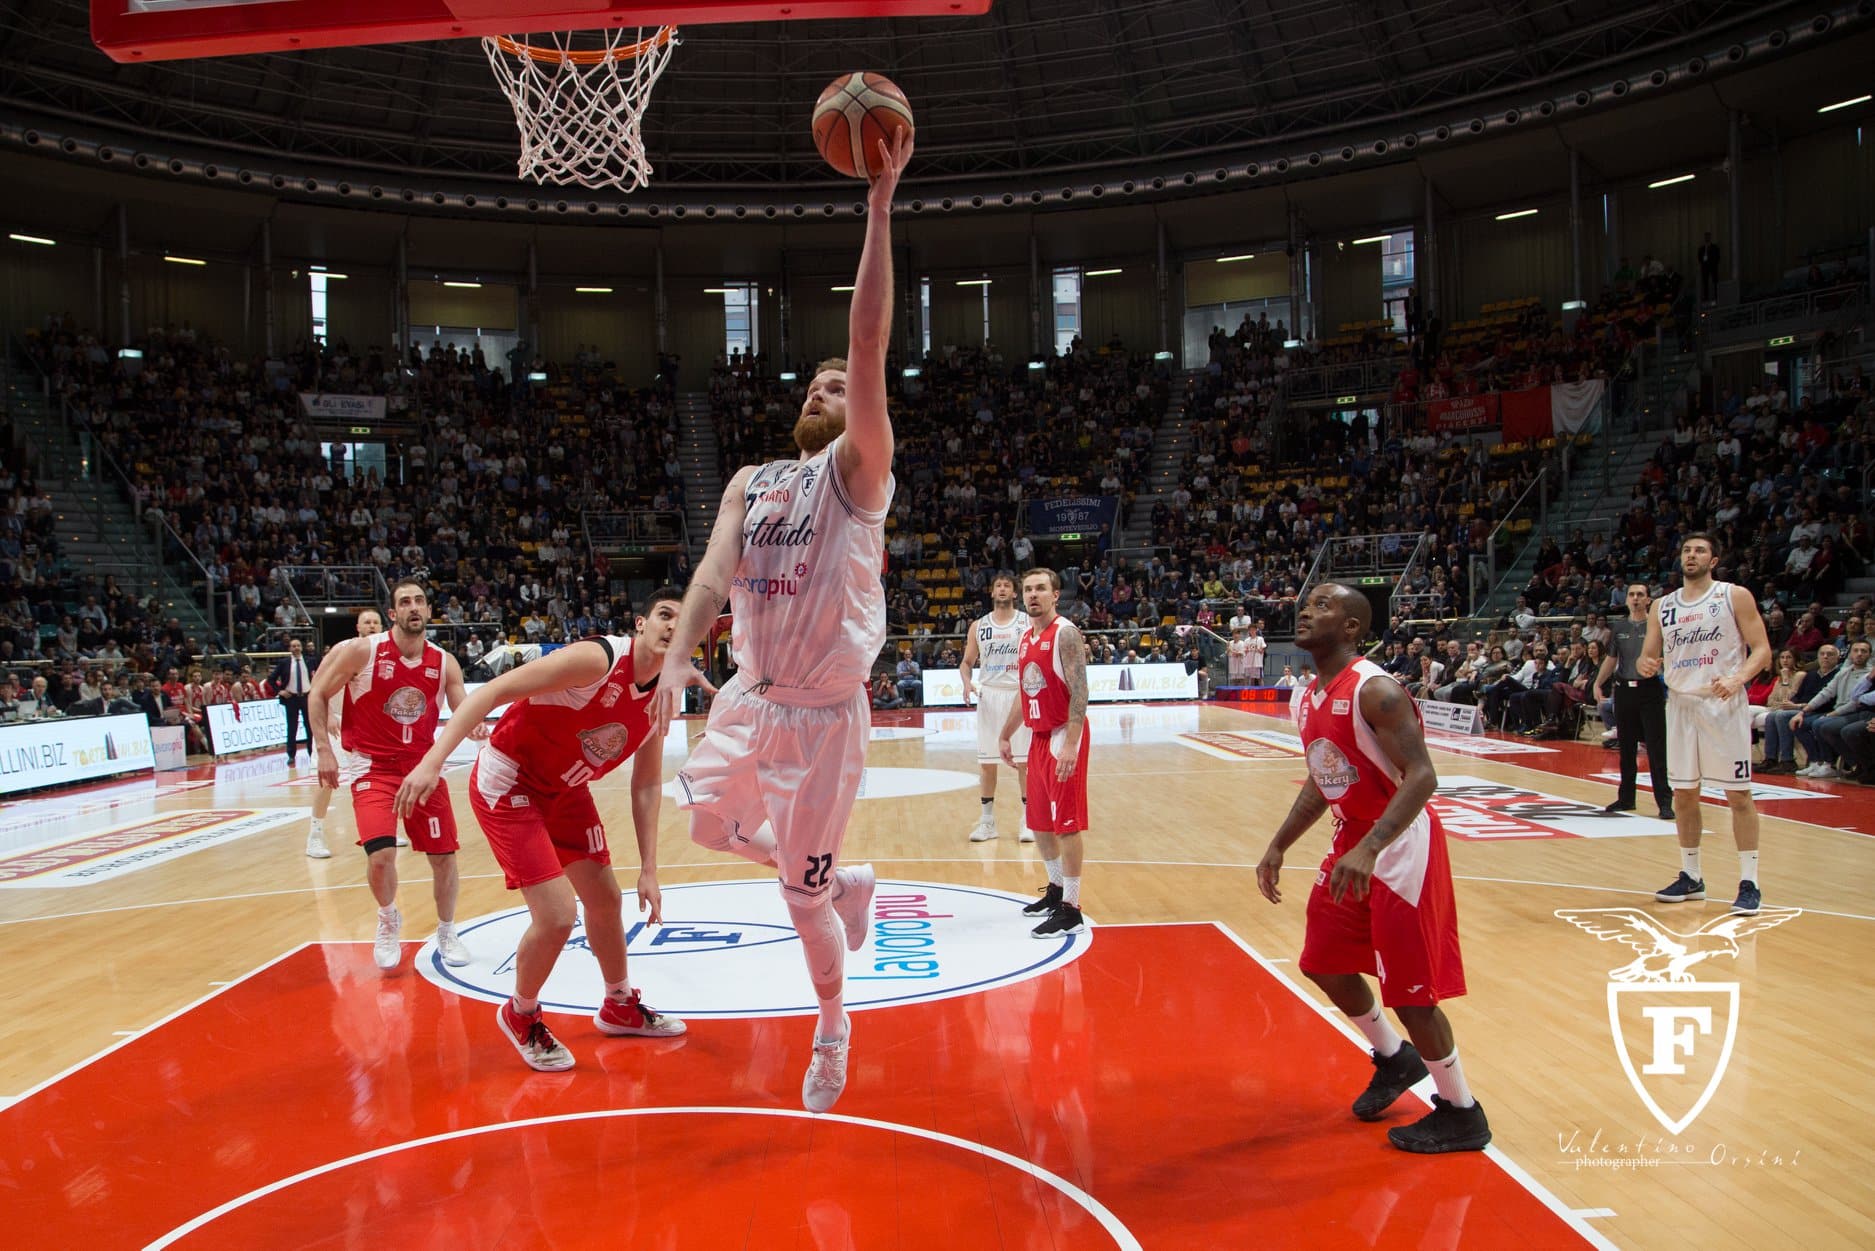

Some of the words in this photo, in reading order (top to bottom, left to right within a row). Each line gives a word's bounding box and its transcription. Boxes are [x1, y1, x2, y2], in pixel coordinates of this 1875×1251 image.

[1044, 497, 1102, 511] FEDELISSIMI
[1662, 607, 1676, 627] 21
[980, 627, 993, 641] 20
[1665, 625, 1725, 653] Fortitudo
[402, 724, 413, 744] 0
[0, 742, 67, 775] LLINI.BIZ
[1734, 760, 1750, 779] 21
[560, 759, 594, 788] 10
[1318, 774, 1349, 787] akery
[428, 816, 441, 839] 0
[585, 824, 604, 854] 10
[803, 852, 832, 888] 22
[847, 895, 954, 980] lavoropiu
